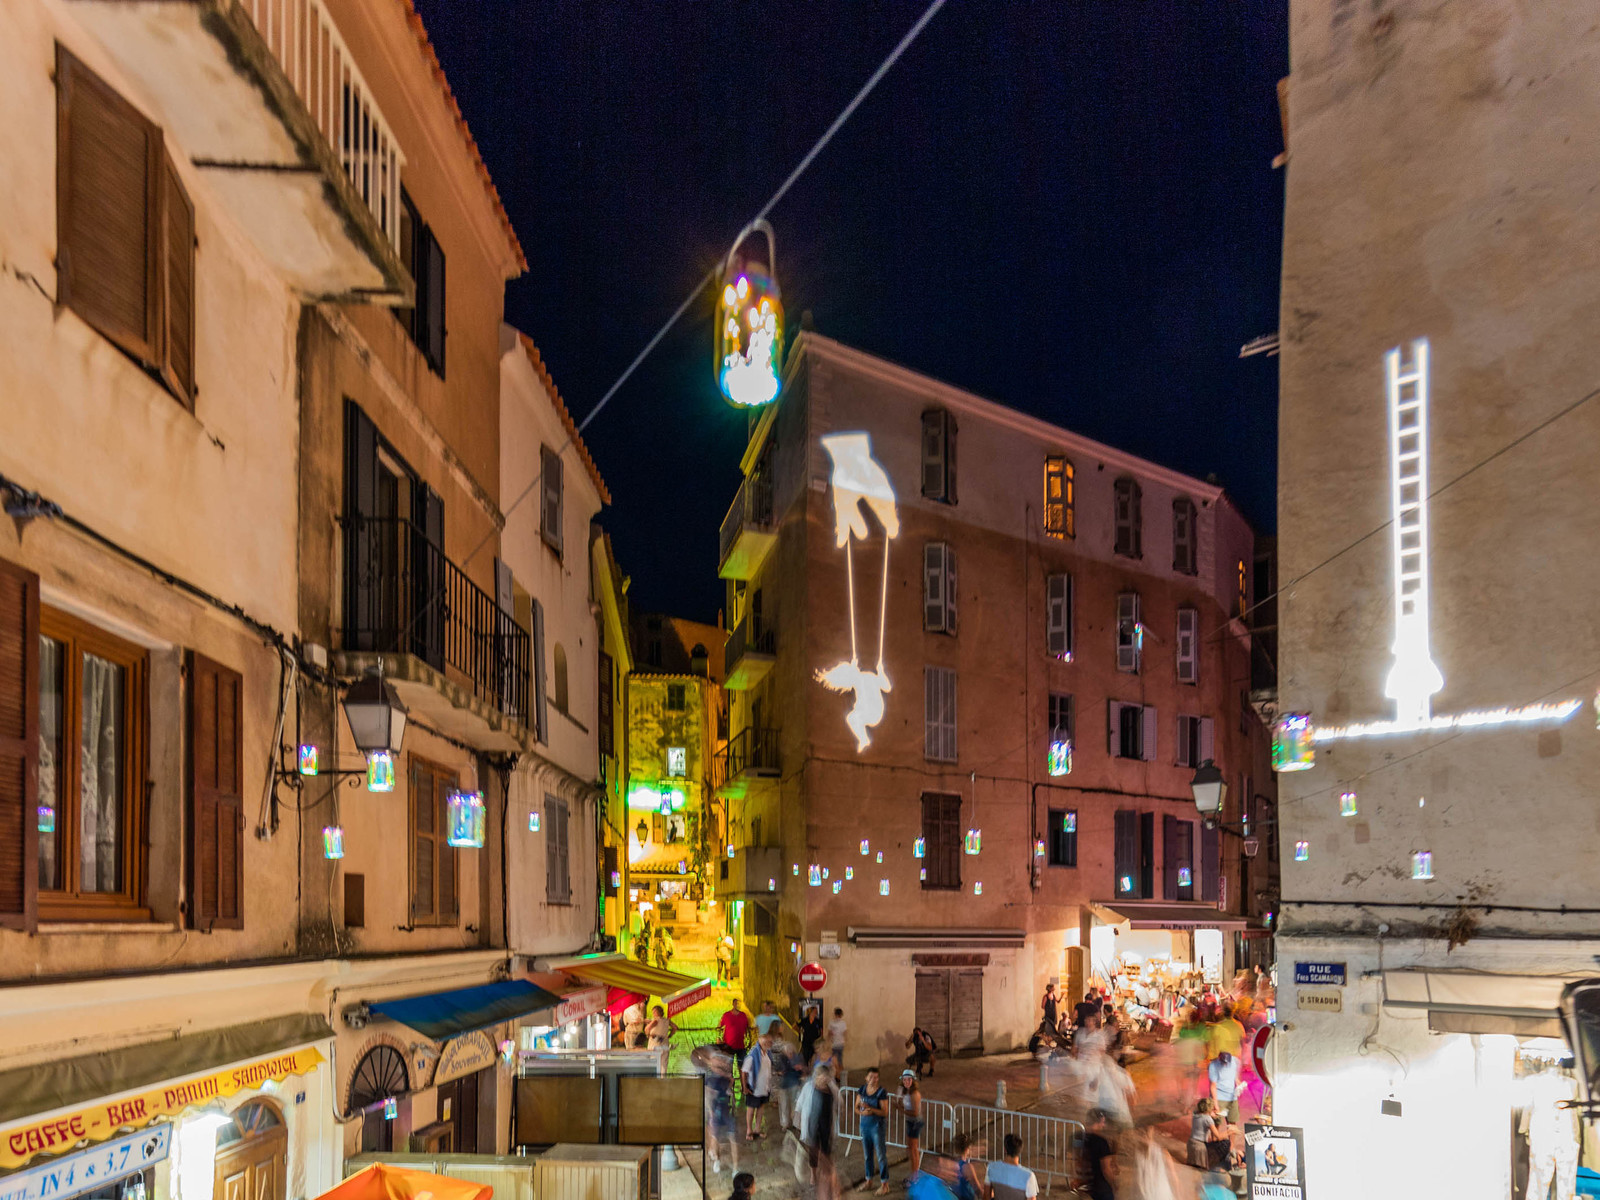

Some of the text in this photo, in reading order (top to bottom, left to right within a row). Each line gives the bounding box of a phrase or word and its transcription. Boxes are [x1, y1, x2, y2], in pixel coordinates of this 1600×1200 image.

[1308, 965, 1331, 973] RUE
[1300, 996, 1339, 1005] U STRADUN
[9, 1115, 86, 1156] CAFFE
[106, 1097, 148, 1127] BAR
[164, 1078, 219, 1109] PANINI
[232, 1055, 297, 1089] SANDWICH
[40, 1170, 62, 1198] IN
[65, 1161, 76, 1187] 4
[104, 1143, 131, 1177] 3.7
[1254, 1186, 1299, 1198] BONIFACIO
